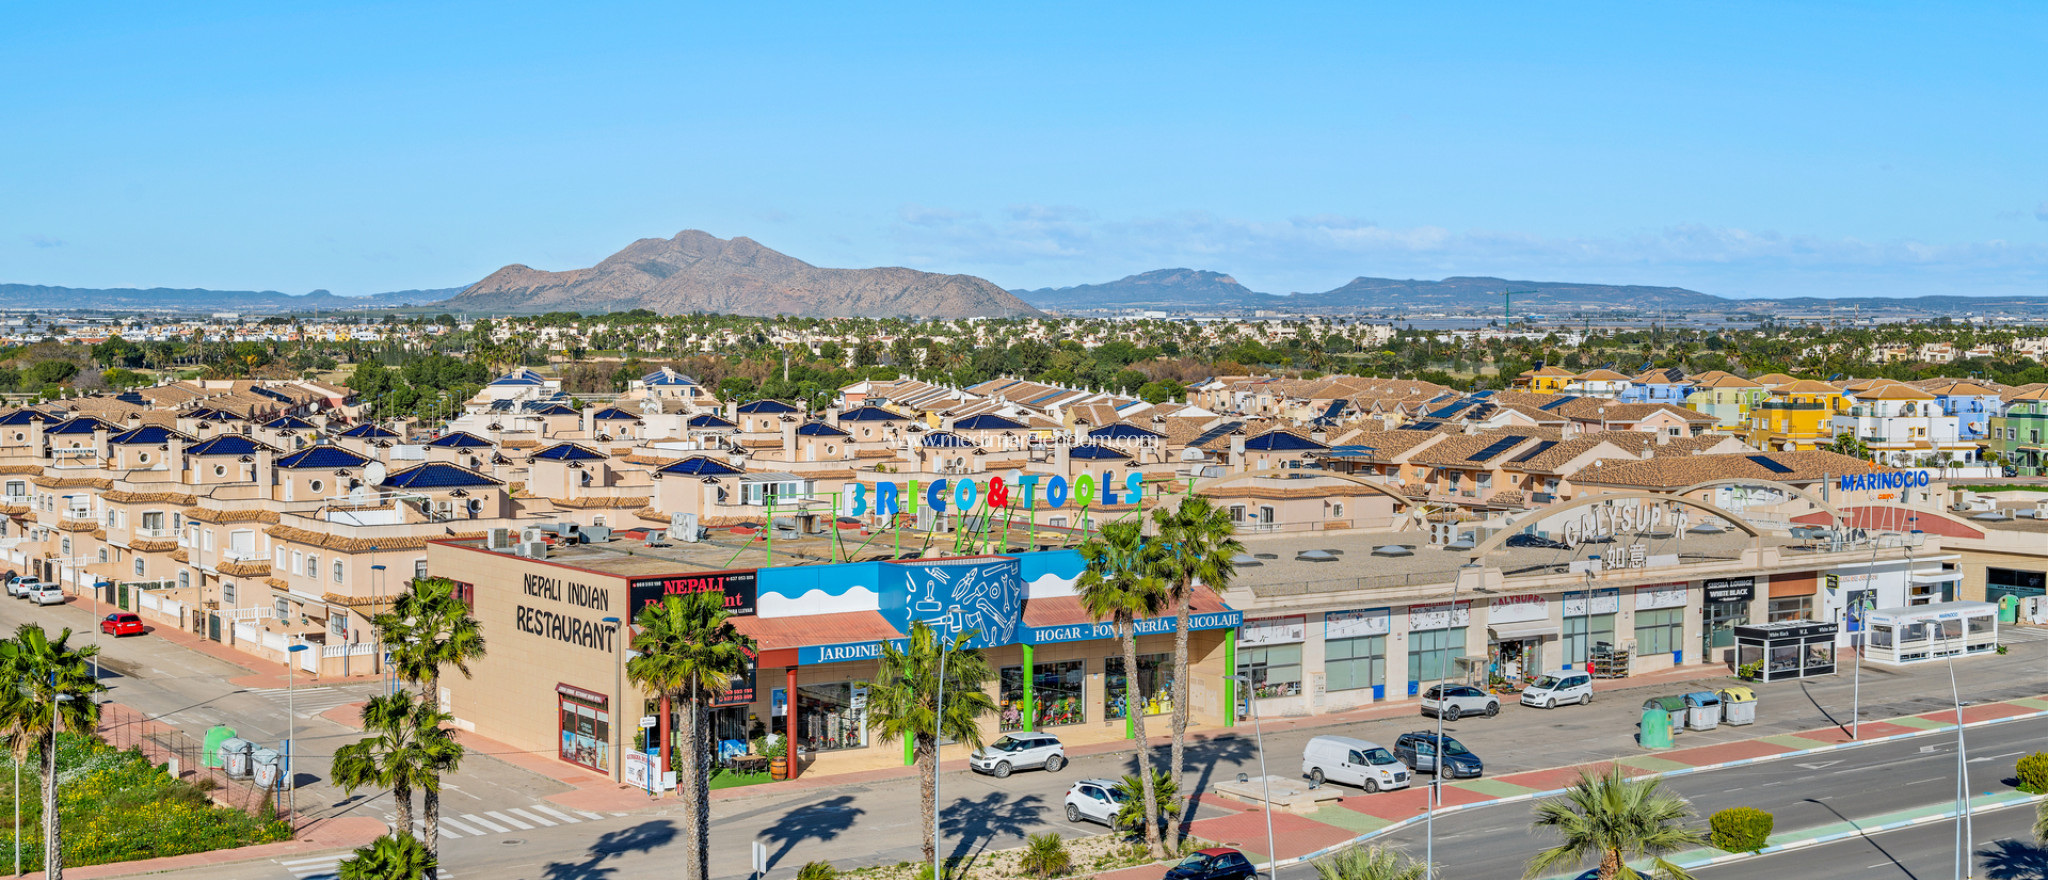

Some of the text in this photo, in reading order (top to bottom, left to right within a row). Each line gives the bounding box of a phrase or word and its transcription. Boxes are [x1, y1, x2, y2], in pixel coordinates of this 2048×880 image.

[1841, 470, 1929, 492] MARINOCIO
[1564, 504, 1688, 548] CALYSUPR
[1607, 542, 1647, 570] 如意
[524, 573, 561, 602] NEPALI
[568, 581, 609, 611] INDIAN
[663, 577, 725, 595] NEPALI
[1710, 590, 1729, 598] WHITE
[517, 605, 616, 653] RESTAURANT
[1035, 613, 1240, 642] HOGAR FONNERÍA RICOLAJE
